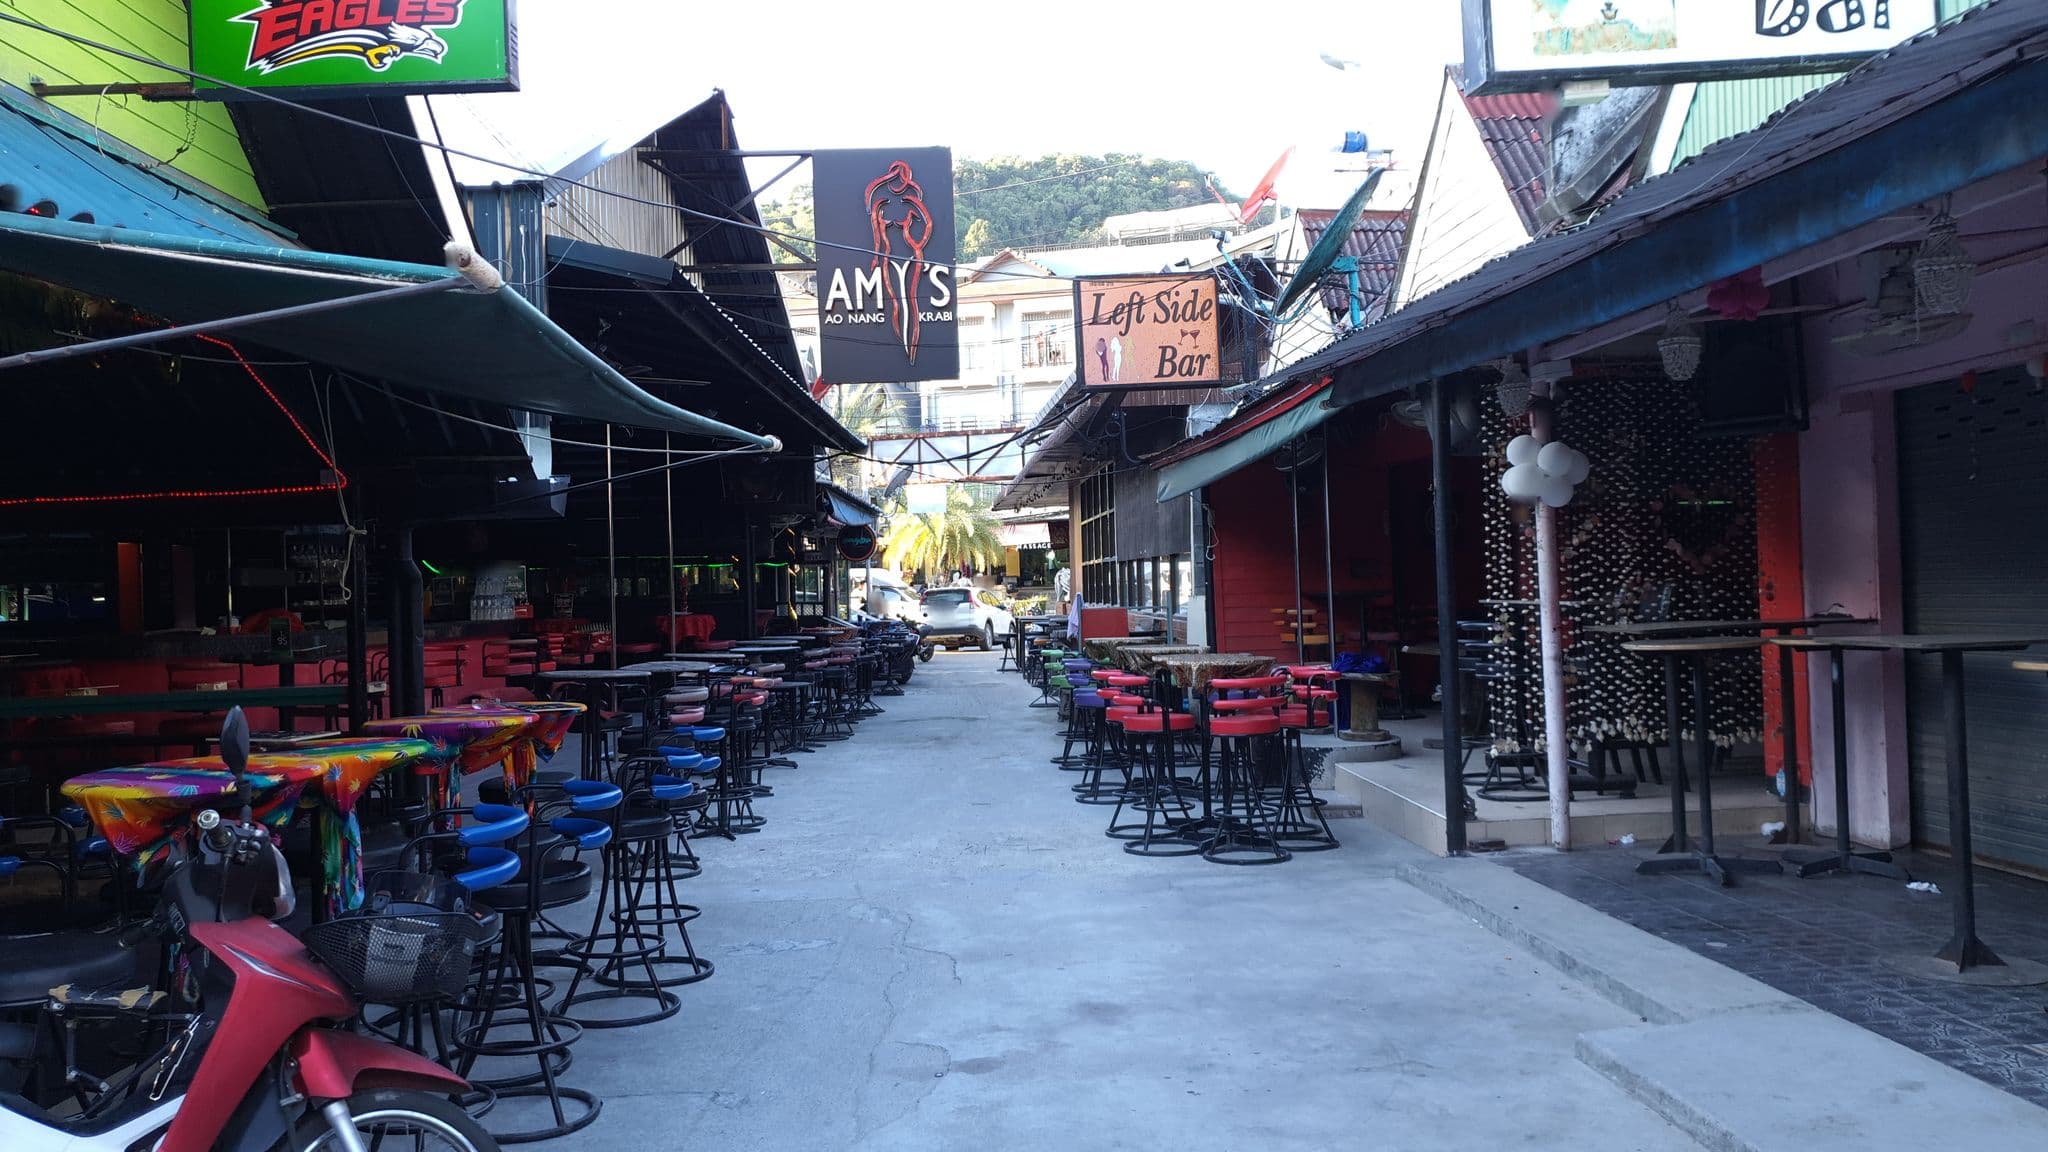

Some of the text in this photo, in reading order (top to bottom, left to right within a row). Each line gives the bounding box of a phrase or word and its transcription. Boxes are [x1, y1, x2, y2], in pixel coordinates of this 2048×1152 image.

[252, 0, 457, 60] EAGLES
[824, 311, 953, 325] AO NANG KRABI
[1088, 288, 1213, 337] Left Side
[1154, 345, 1211, 378] Bar
